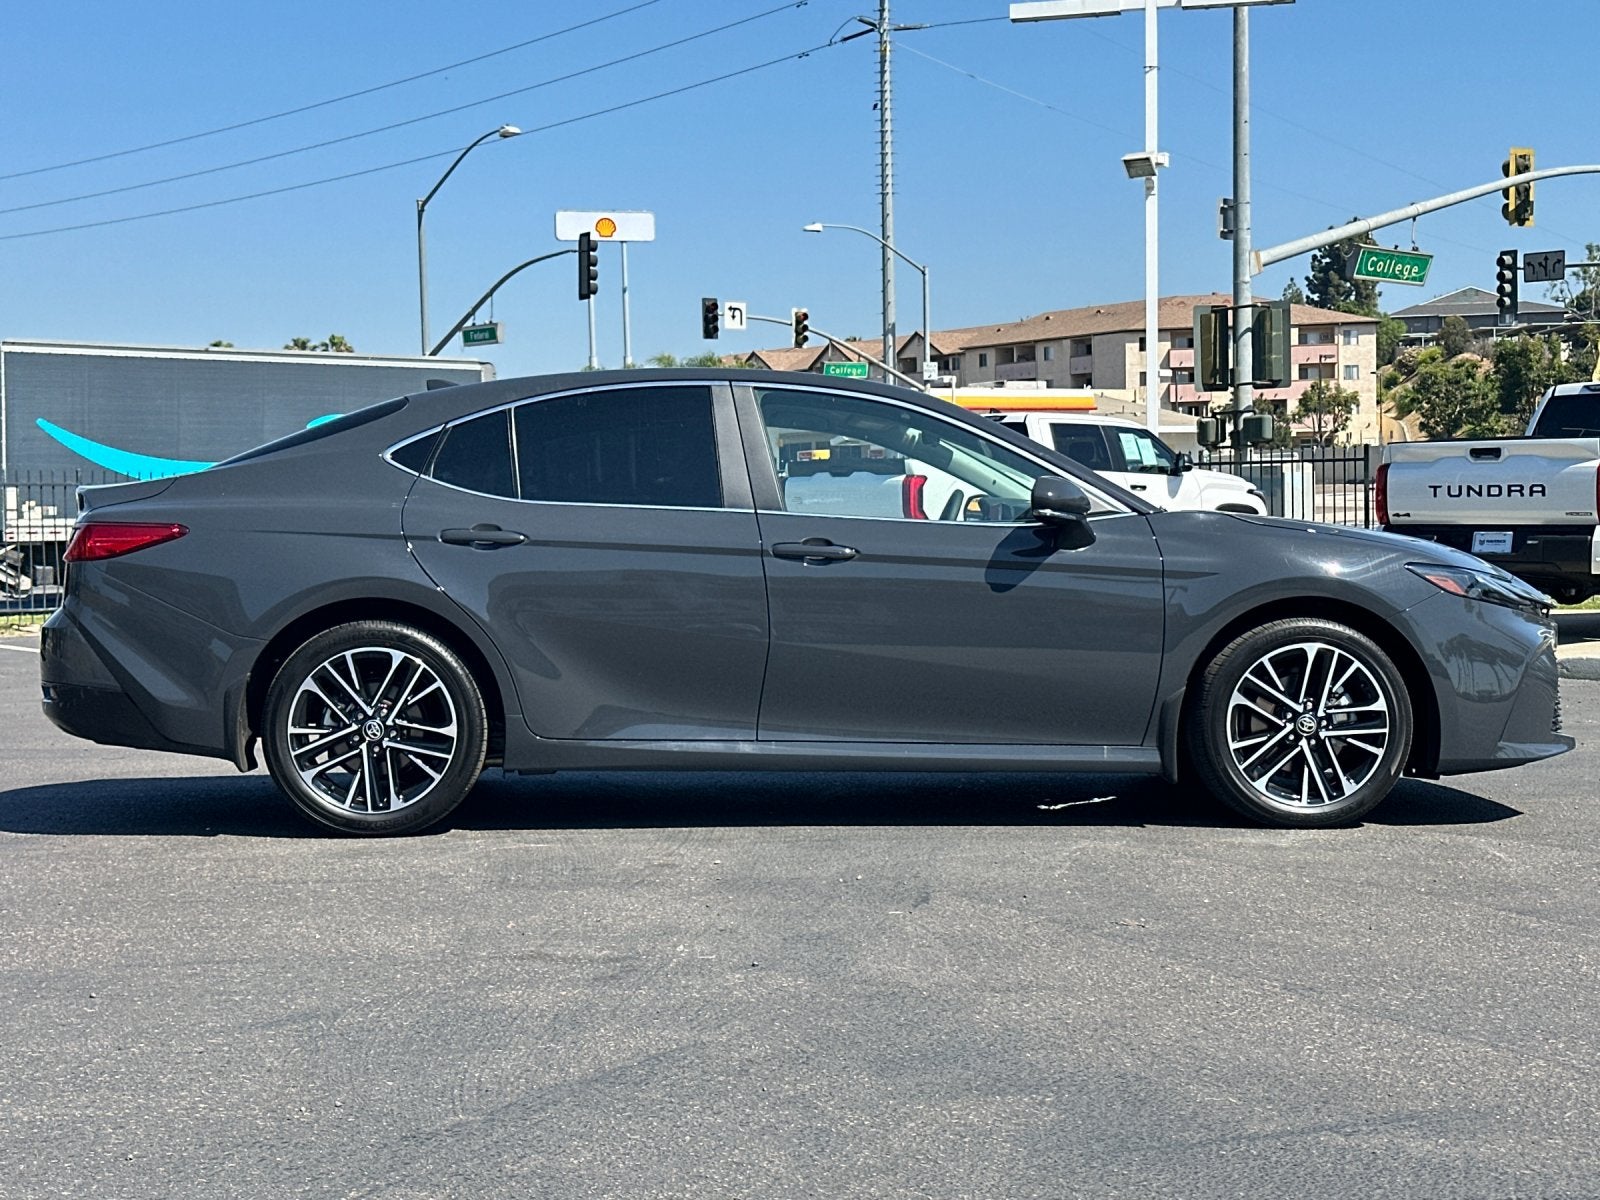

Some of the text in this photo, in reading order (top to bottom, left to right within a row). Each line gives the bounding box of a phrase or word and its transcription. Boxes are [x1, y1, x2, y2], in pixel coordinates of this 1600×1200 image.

[1367, 256, 1420, 280] College
[829, 366, 862, 376] College
[1428, 483, 1547, 498] TUNDRA
